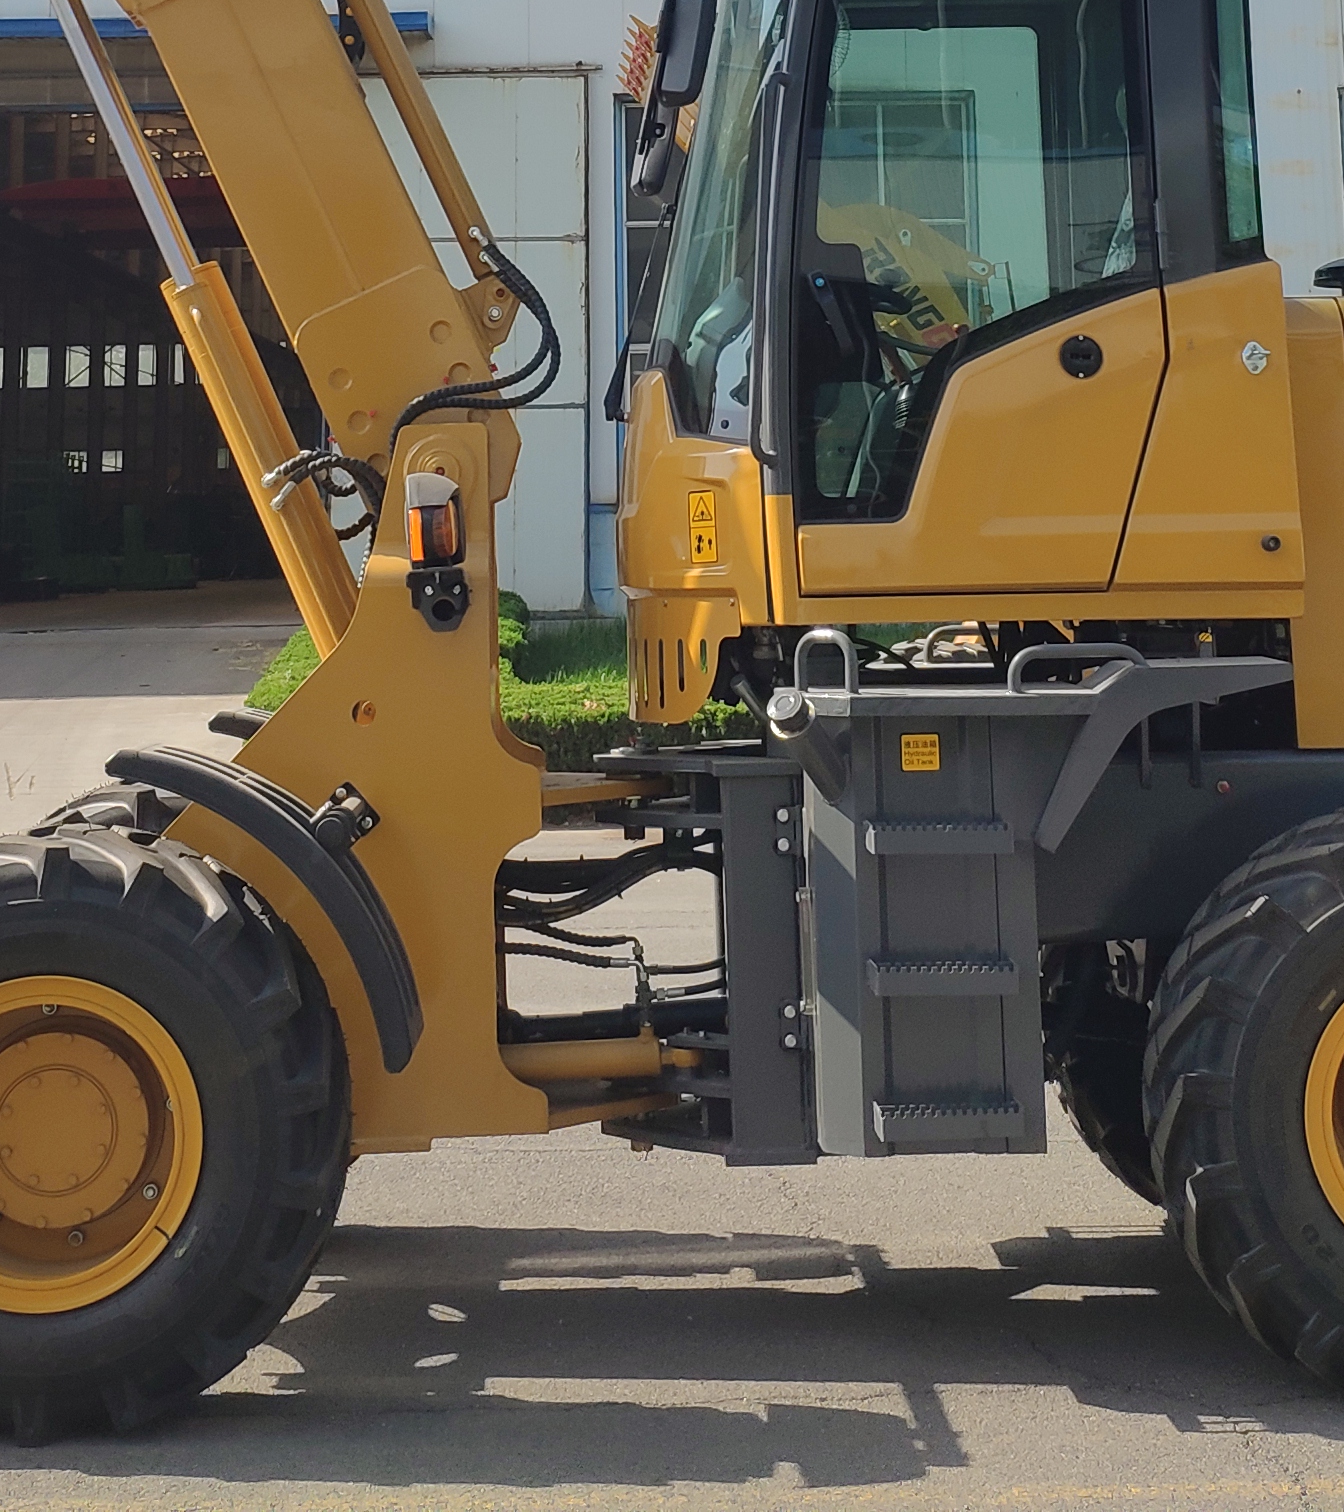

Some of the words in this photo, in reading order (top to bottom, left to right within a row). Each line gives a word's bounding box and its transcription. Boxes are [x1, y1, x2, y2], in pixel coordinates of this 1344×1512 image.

[903, 740, 937, 748] 液压油箱
[904, 750, 937, 758] Hydraulic
